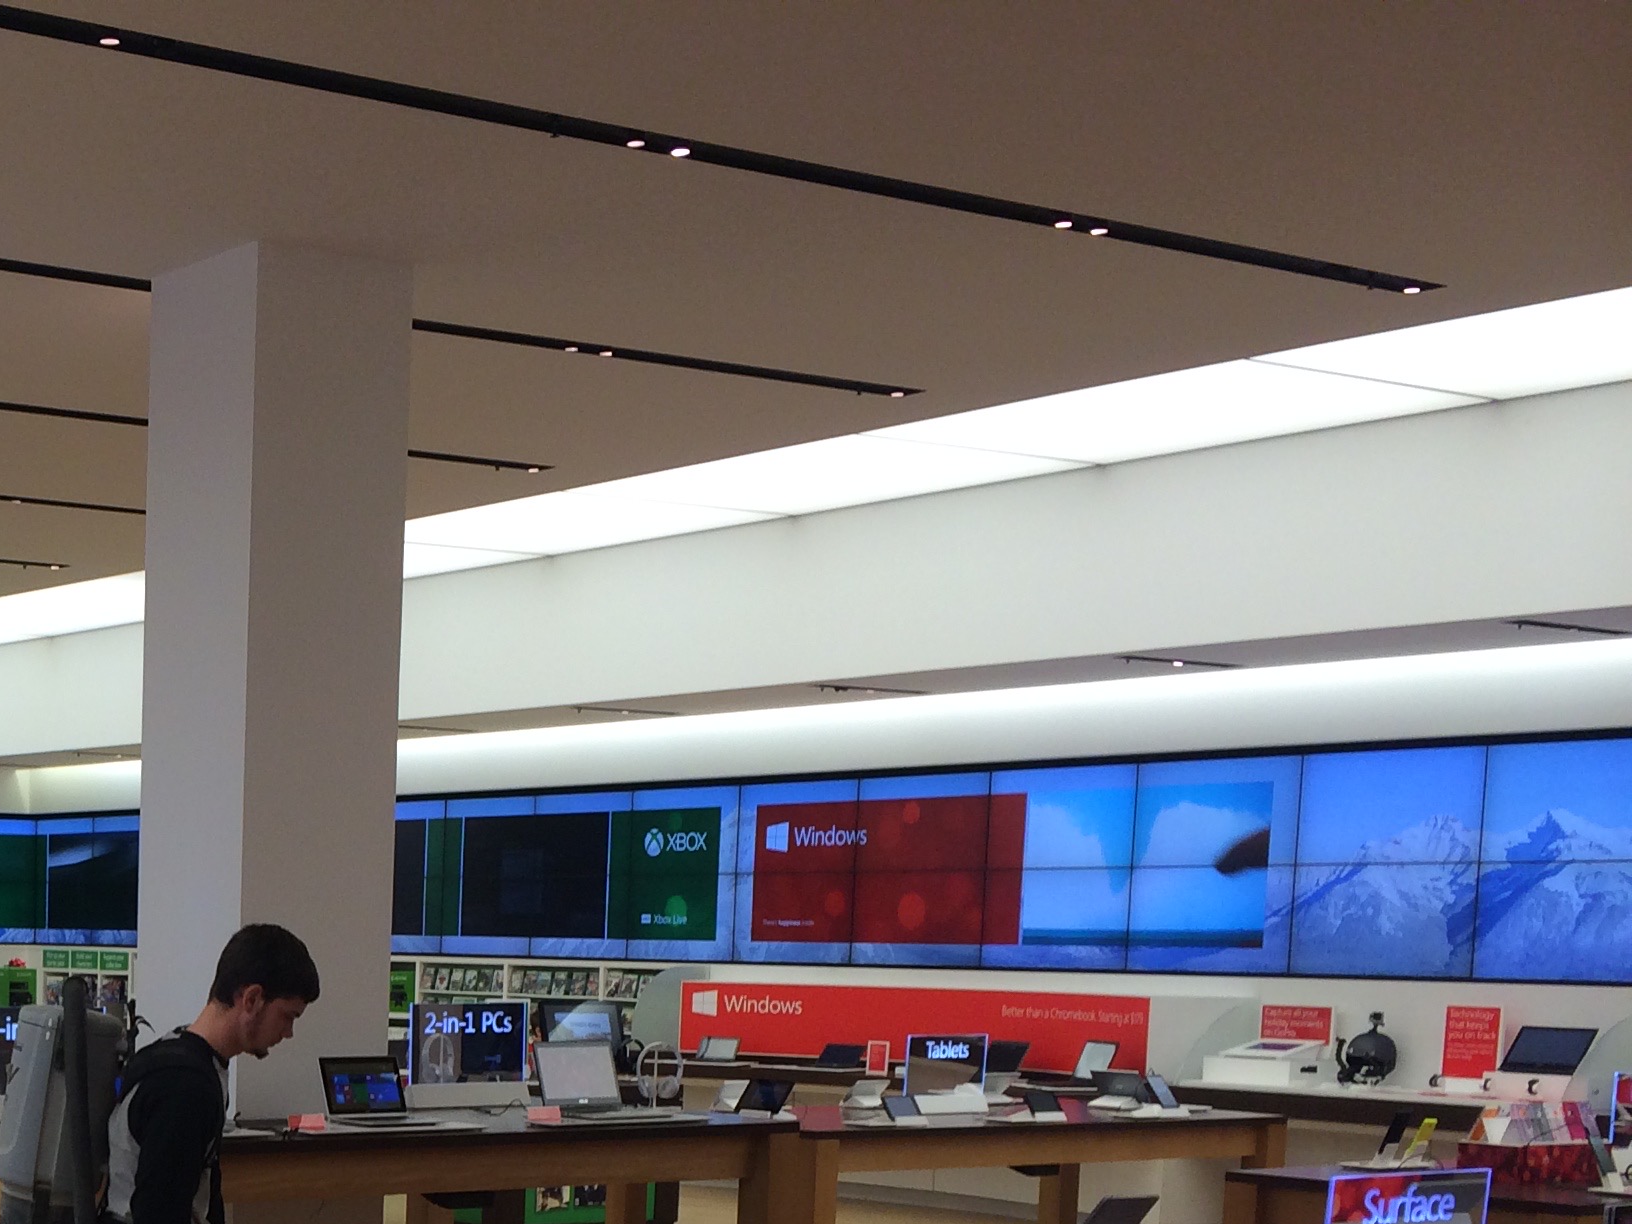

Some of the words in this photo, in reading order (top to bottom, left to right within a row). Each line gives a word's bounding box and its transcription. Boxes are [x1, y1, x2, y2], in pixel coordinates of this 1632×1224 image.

[666, 832, 707, 851] XBOX
[794, 824, 867, 847] Windows
[653, 914, 671, 924] Xbox
[672, 914, 688, 925] Live
[724, 994, 803, 1015] Windows
[1002, 1004, 1024, 1018] Better
[1026, 1006, 1043, 1019] than
[424, 1011, 476, 1034] 2-in-1
[482, 1011, 513, 1033] PCs
[1450, 1009, 1495, 1021] Technology
[1449, 1020, 1465, 1029] that
[1466, 1020, 1490, 1030] keeps
[1448, 1032, 1463, 1040] you
[1477, 1031, 1496, 1040] track
[926, 1040, 970, 1059] Tablets
